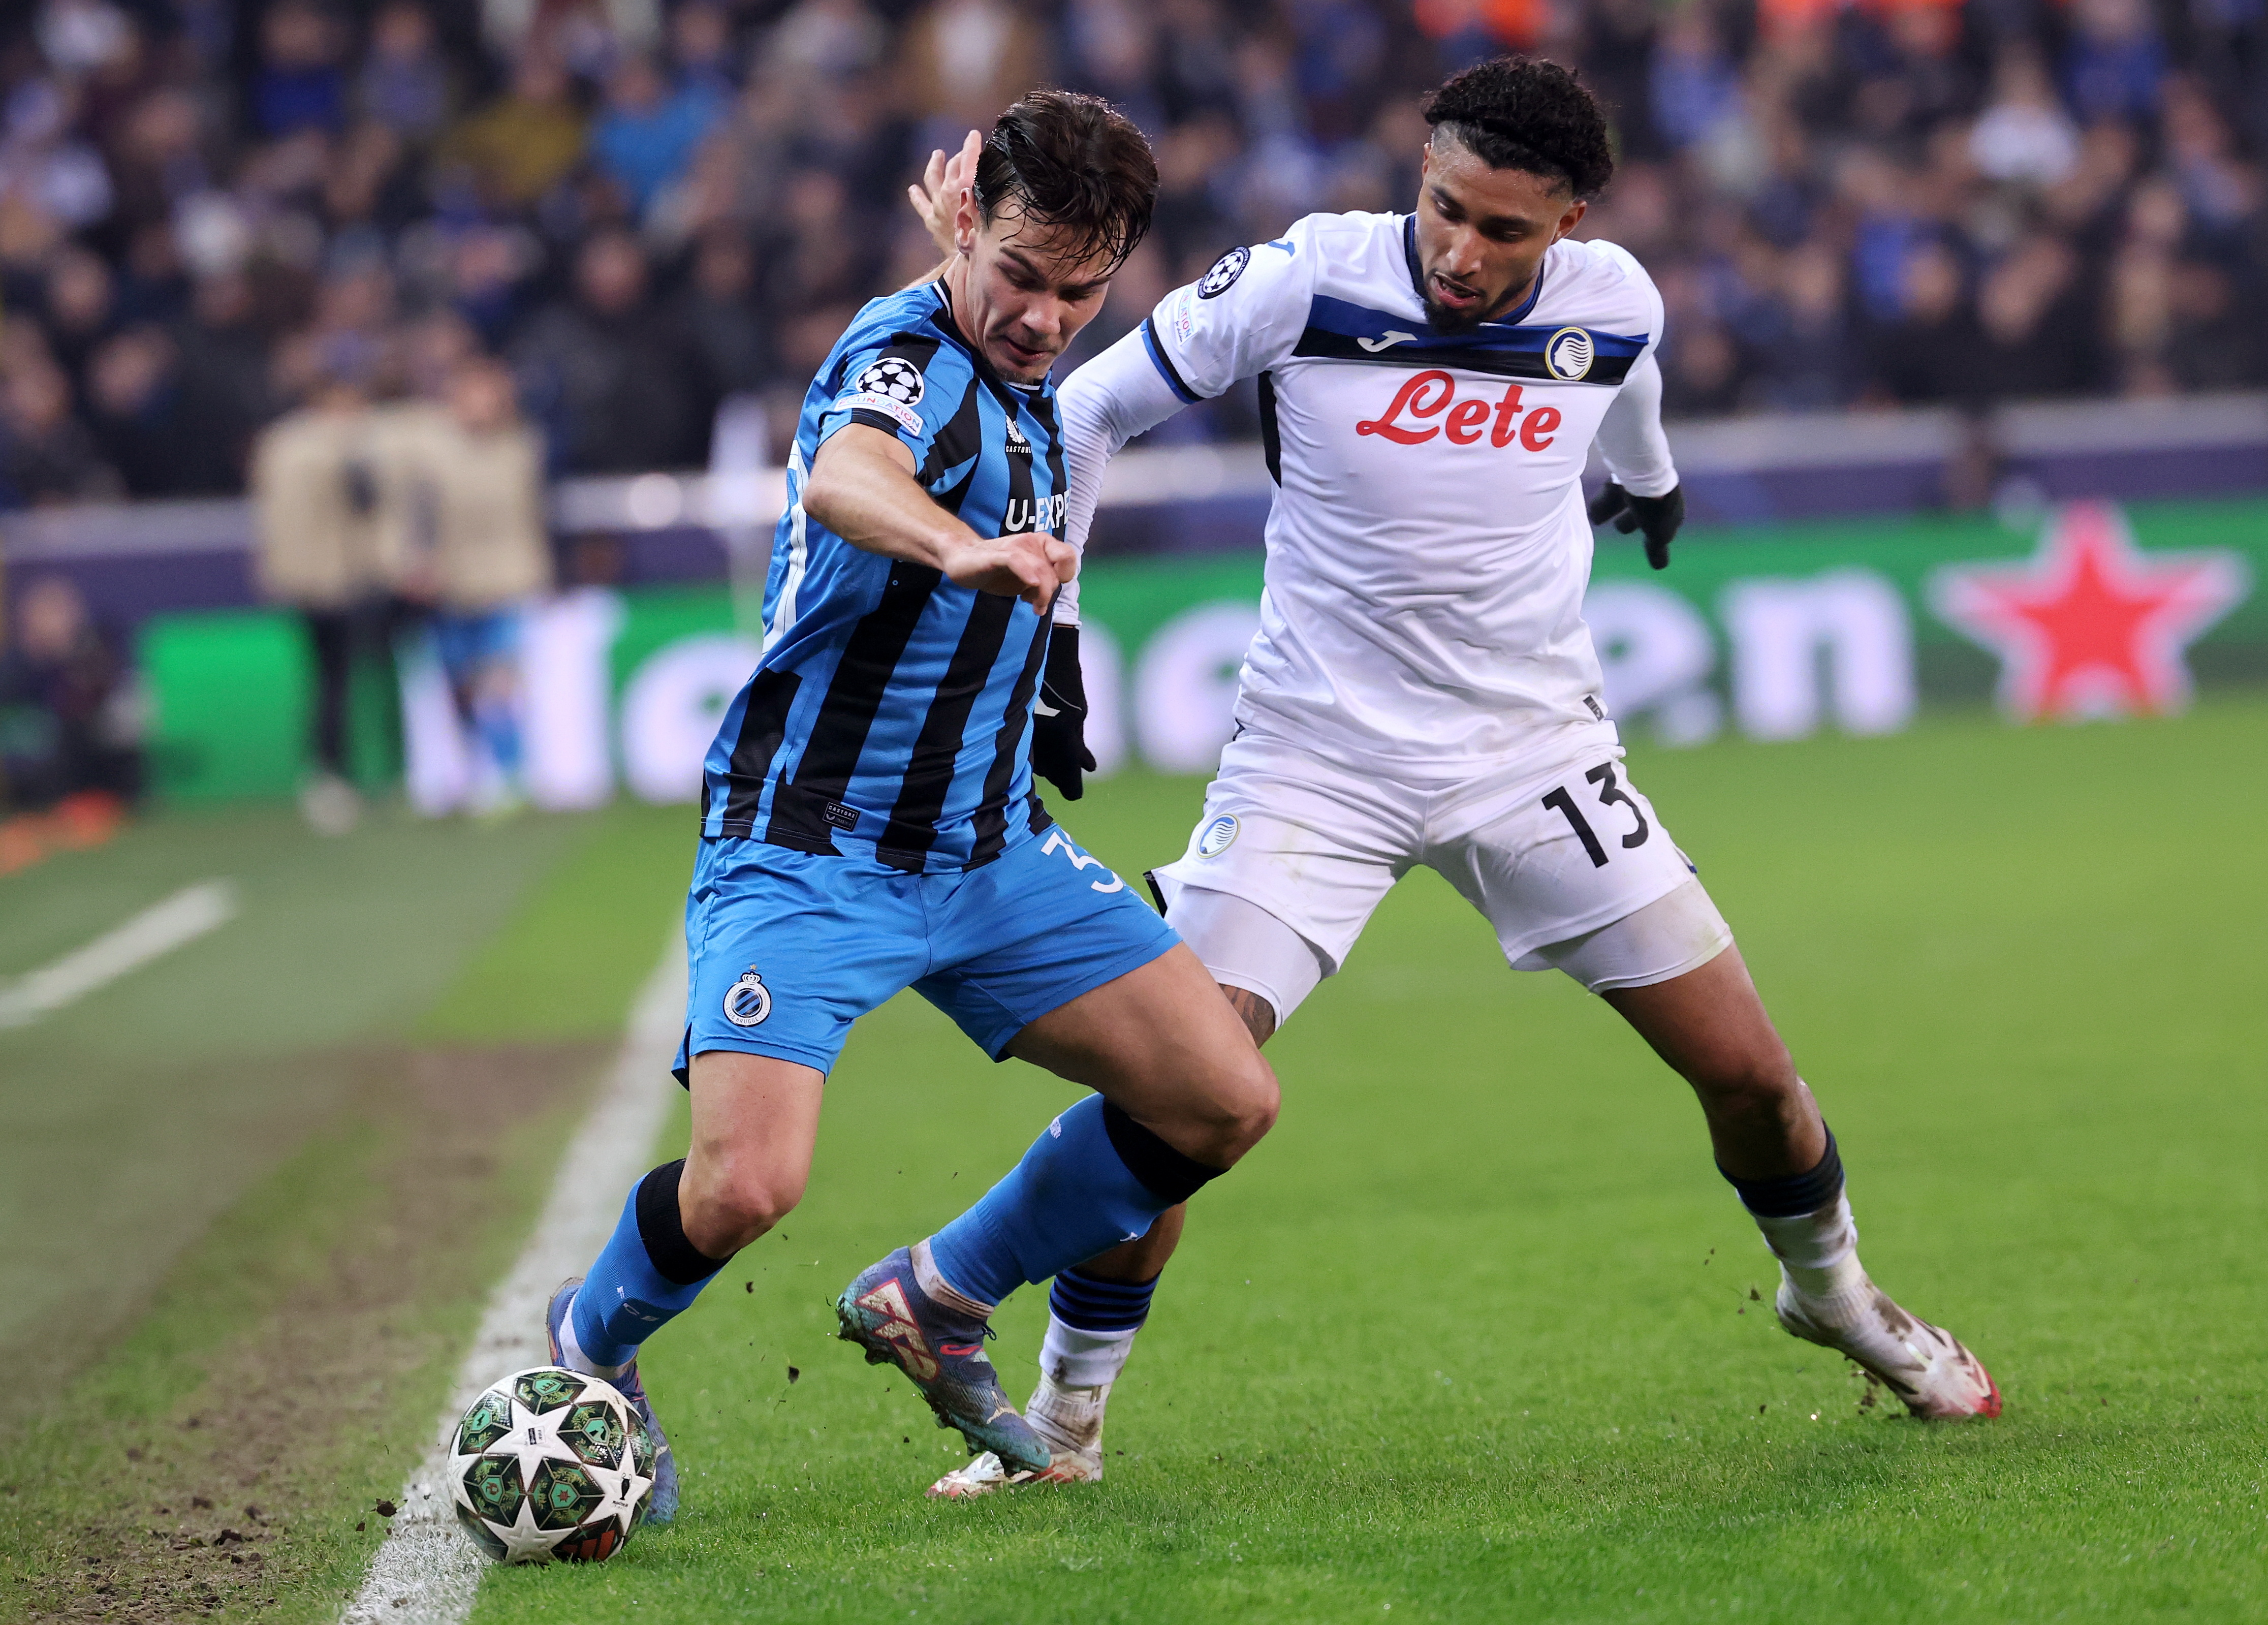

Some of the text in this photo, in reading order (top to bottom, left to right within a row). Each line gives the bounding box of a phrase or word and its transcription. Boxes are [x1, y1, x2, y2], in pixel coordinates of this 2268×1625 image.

[839, 397, 921, 429] FOUNDATION
[1356, 370, 1561, 452] Lete
[829, 805, 855, 818] CASTORE
[1541, 762, 1649, 868] 13
[1041, 828, 1124, 893] 3
[726, 1007, 735, 1019] CLUB
